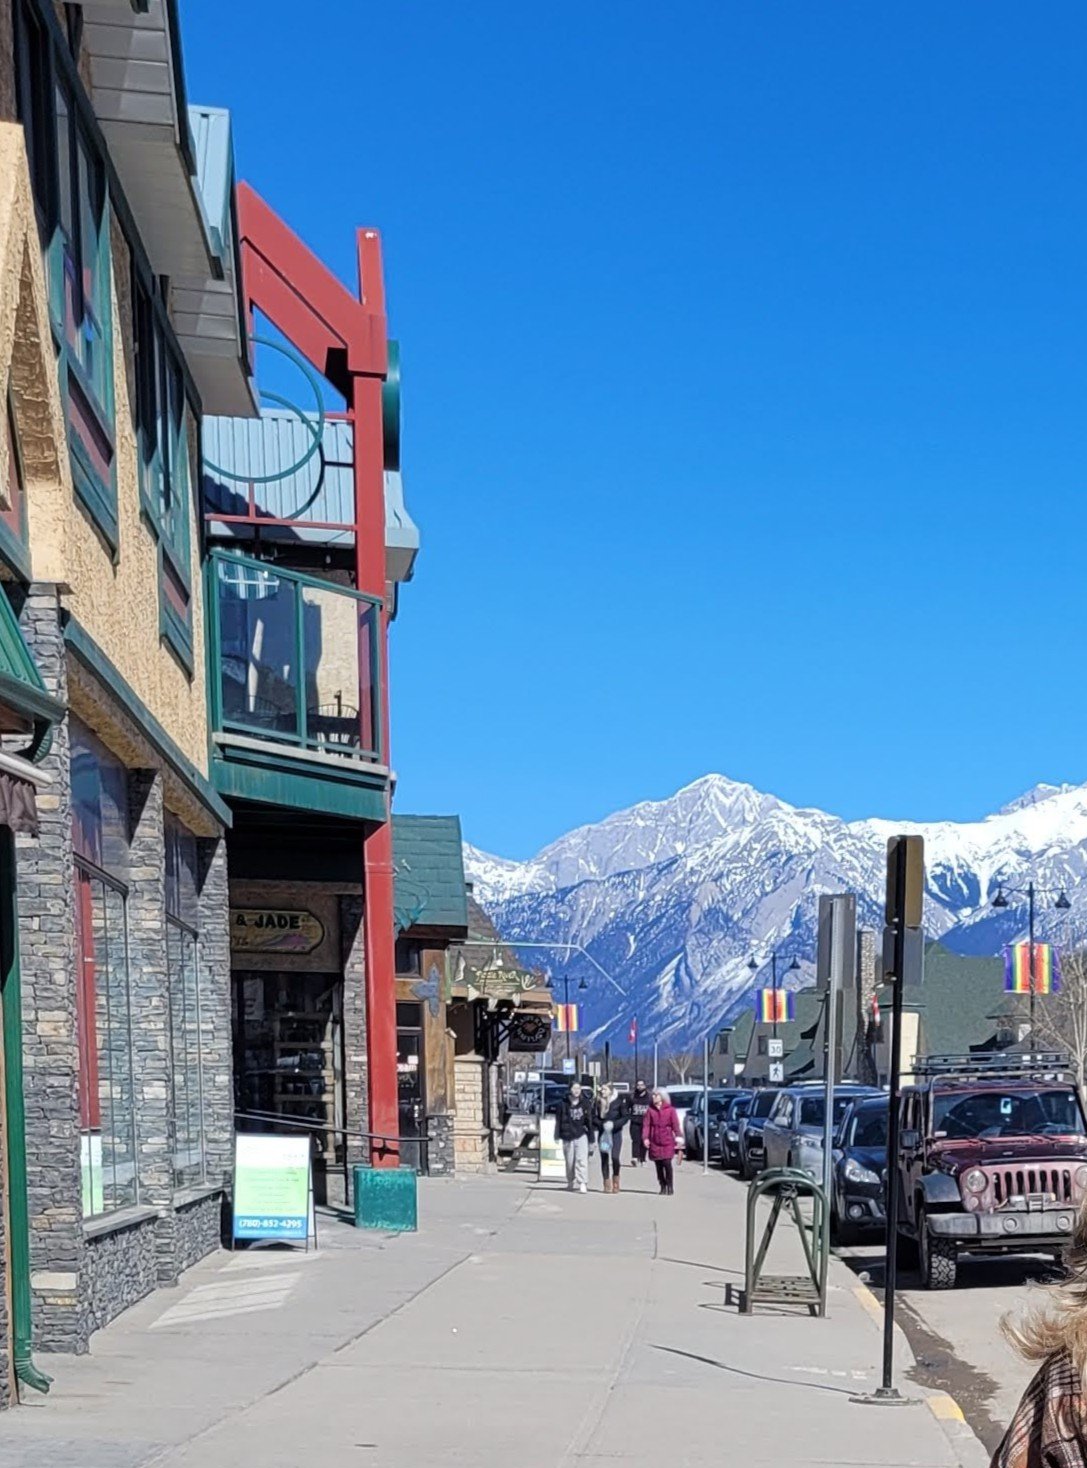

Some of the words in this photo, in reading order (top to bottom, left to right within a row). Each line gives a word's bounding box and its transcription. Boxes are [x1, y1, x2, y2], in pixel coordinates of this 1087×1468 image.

[236, 914, 247, 926] &
[255, 914, 300, 929] JADE
[771, 1046, 782, 1054] 30
